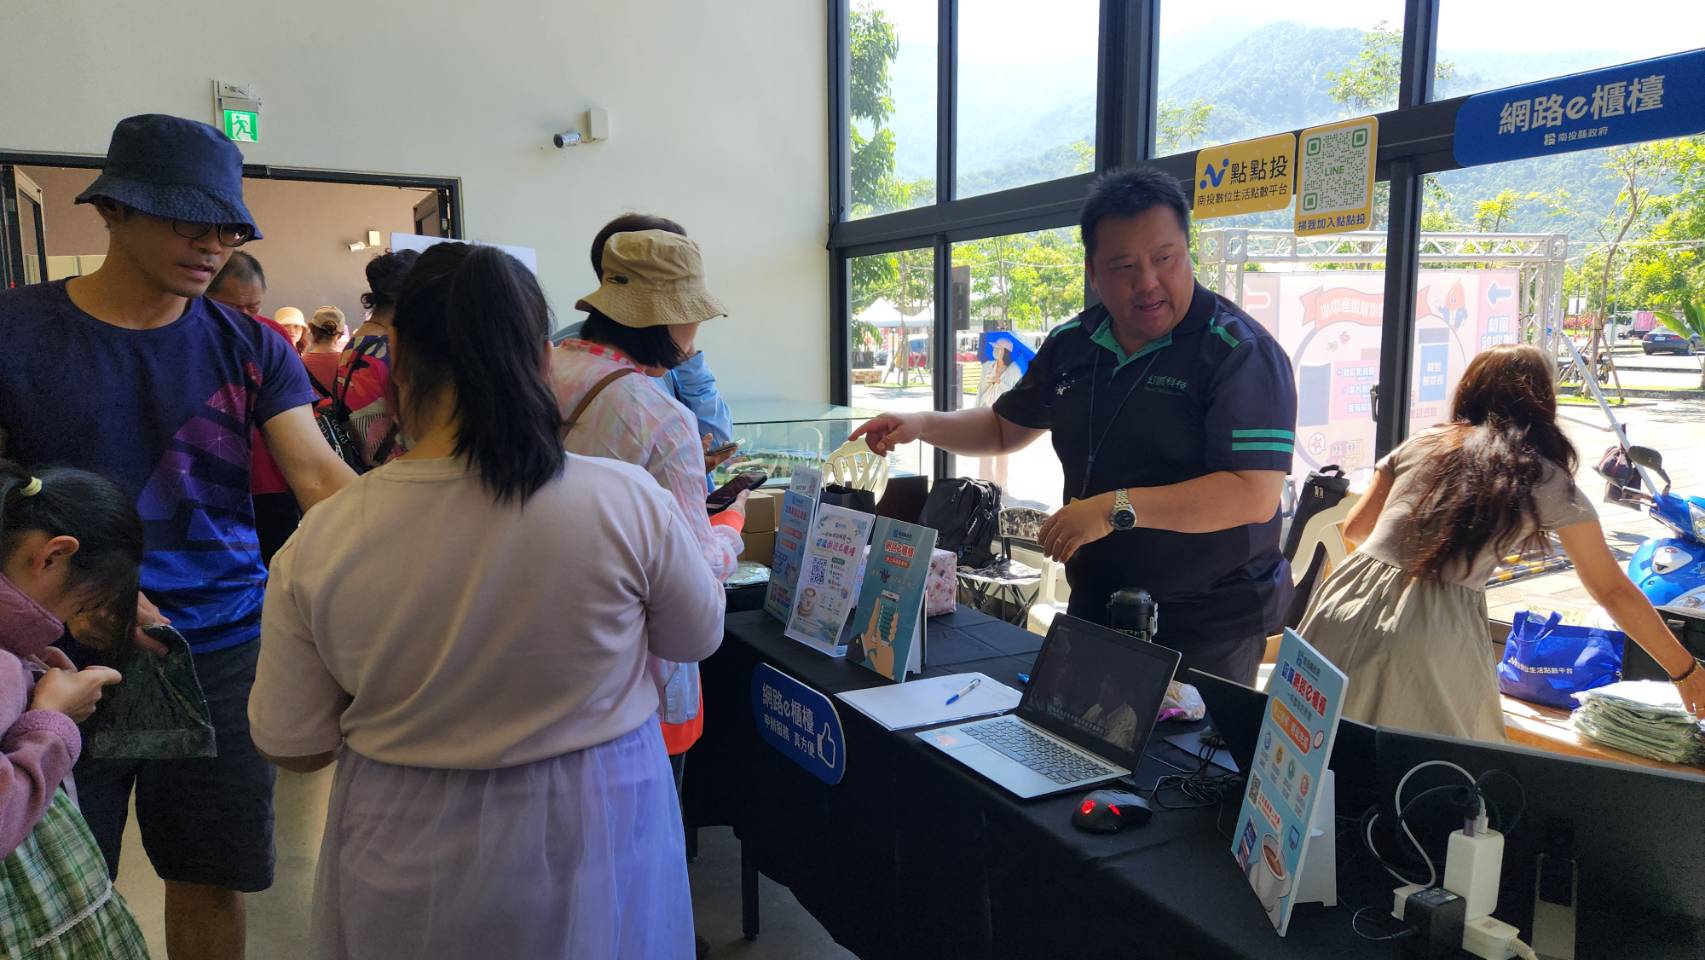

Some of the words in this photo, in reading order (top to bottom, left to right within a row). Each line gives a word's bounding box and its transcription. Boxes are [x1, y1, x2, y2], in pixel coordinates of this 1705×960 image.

[1498, 75, 1666, 135] 網路e櫃檯
[1557, 126, 1609, 143] 南投縣政府
[1229, 155, 1289, 185] 點點投
[1324, 165, 1345, 177] LINE
[1197, 183, 1289, 207] 南投數位生活點數平台
[1297, 213, 1367, 231] 掃我加入點點投
